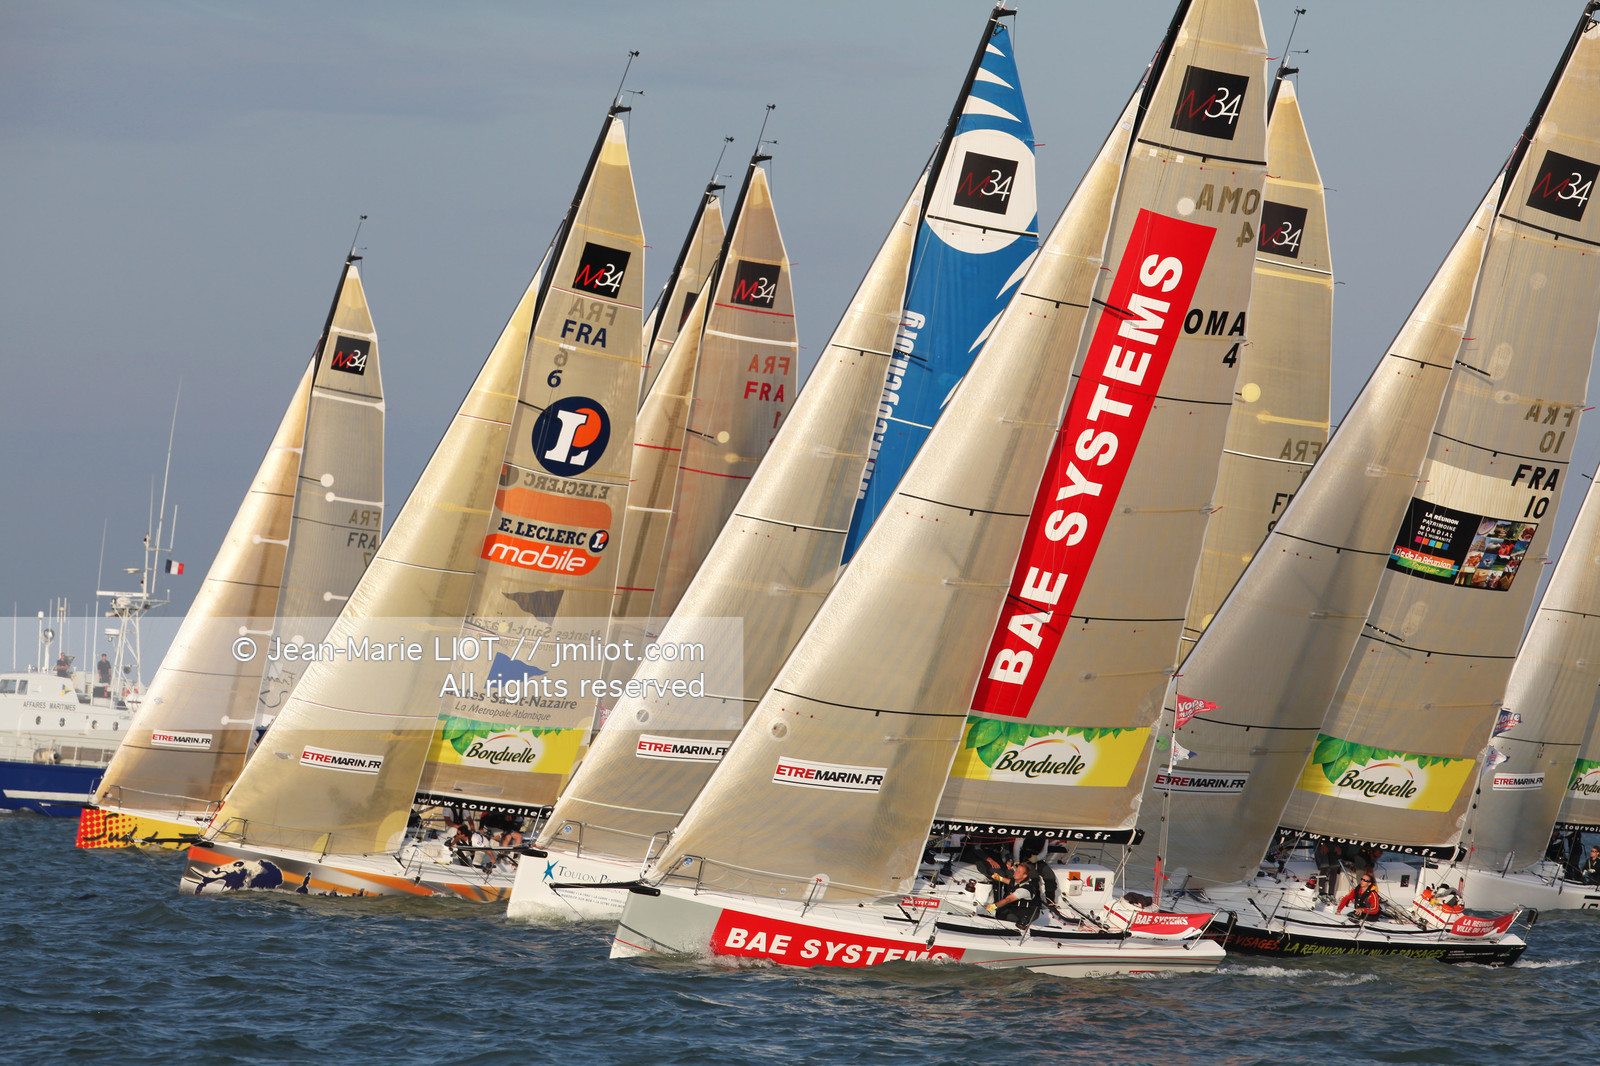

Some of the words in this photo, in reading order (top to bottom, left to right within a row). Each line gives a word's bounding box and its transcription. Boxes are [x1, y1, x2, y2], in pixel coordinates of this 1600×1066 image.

[1175, 87, 1242, 125] M34
[957, 169, 1012, 202] M34
[1532, 172, 1592, 208] M34
[1260, 221, 1302, 252] M34
[574, 263, 624, 293] M34
[733, 277, 776, 304] M34
[1184, 308, 1246, 336] OMA
[560, 319, 607, 348] FRA
[332, 349, 367, 371] M34
[1222, 343, 1240, 368] 4
[547, 370, 563, 387] 6
[744, 381, 784, 403] FRA
[988, 566, 1069, 686] BAE
[1044, 254, 1184, 547] SYSTEMS
[1511, 463, 1560, 491] FRA
[1524, 495, 1550, 519] 10
[498, 517, 587, 546] E.LECLERC
[1420, 525, 1453, 538] MONDIAL
[1422, 519, 1457, 532] PATRIMOINE
[347, 532, 378, 550] FRA
[488, 543, 586, 572] mobile
[1422, 556, 1452, 569] Réunion
[23, 701, 46, 709] AFFAIRES
[49, 703, 76, 711] MARITIMES
[468, 702, 511, 718] Metropole
[512, 710, 551, 722] Atlantique
[152, 733, 211, 746] ETREMARIN.FR
[301, 751, 382, 770] ETREMARIN.FR
[465, 742, 536, 764] Bonduelle
[995, 750, 1085, 778] Bonduelle
[775, 764, 884, 786] ETREMARIN.FR
[1155, 774, 1246, 788] ETREMARIN.FR
[1338, 769, 1417, 798] Bonduelle
[1494, 777, 1544, 786] ETREMARIN.FR
[417, 798, 551, 818] www.tourvoile.f
[932, 823, 1111, 841] www.tourvoile.fr
[1280, 829, 1437, 857] www.tourvoile.fr
[1135, 915, 1152, 925] BAE
[1153, 916, 1189, 926] SYSTEMS
[1457, 925, 1471, 933] VILLE
[724, 927, 793, 955] BAE
[1284, 942, 1299, 954] LA
